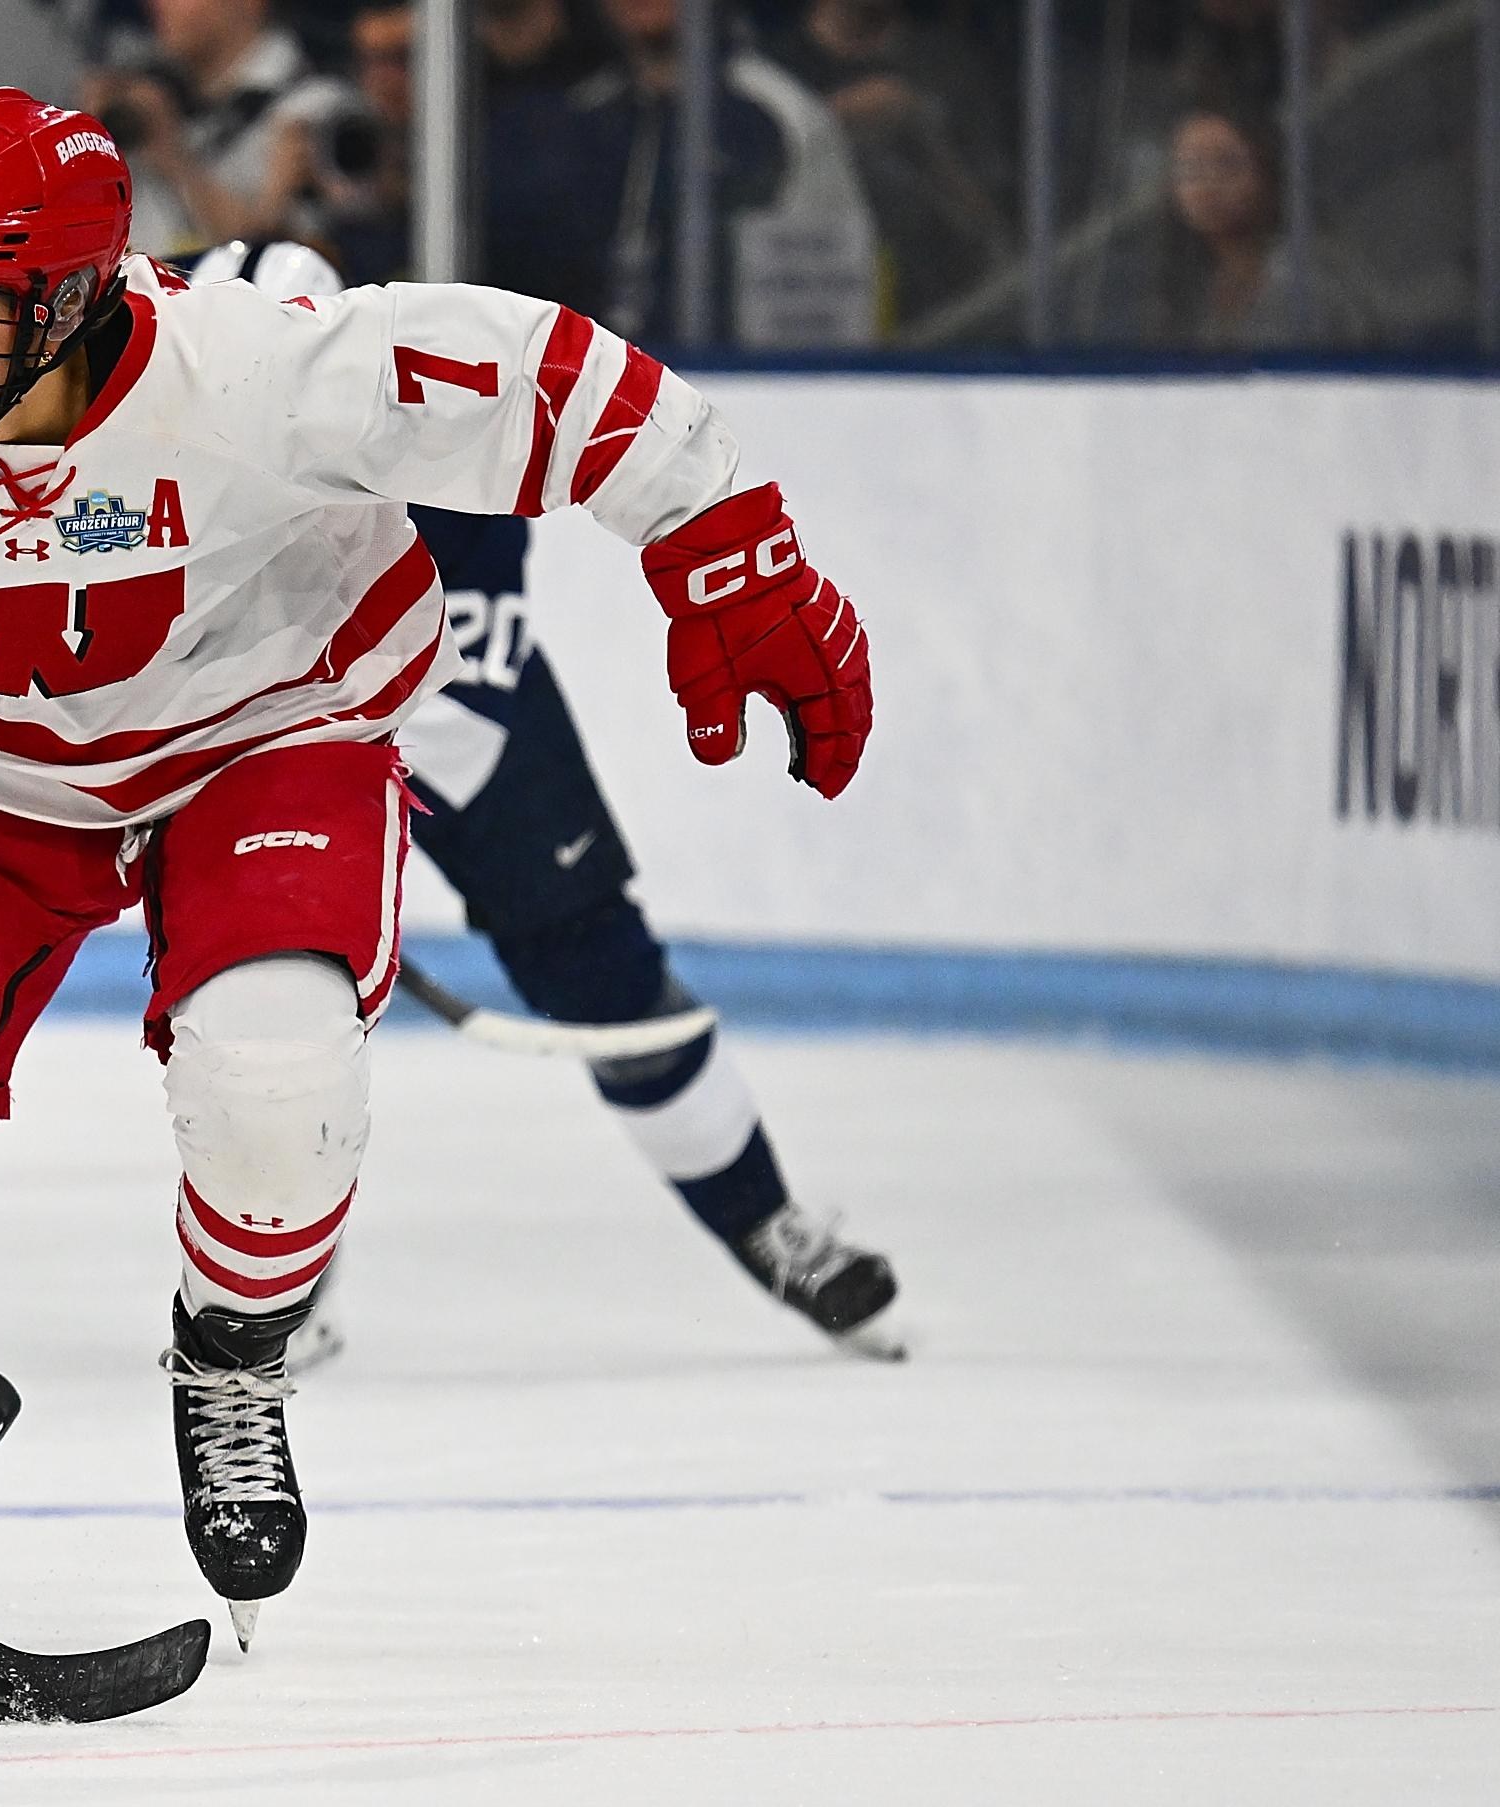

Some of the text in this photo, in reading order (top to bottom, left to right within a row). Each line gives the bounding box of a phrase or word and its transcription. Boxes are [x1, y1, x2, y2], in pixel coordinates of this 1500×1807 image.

[55, 132, 120, 165] BADGERS
[393, 345, 499, 405] 7
[65, 516, 140, 533] FROZEN FOUR
[146, 478, 190, 548] A
[445, 590, 527, 691] 20
[690, 723, 724, 739] CCM
[233, 830, 330, 855] CCM
